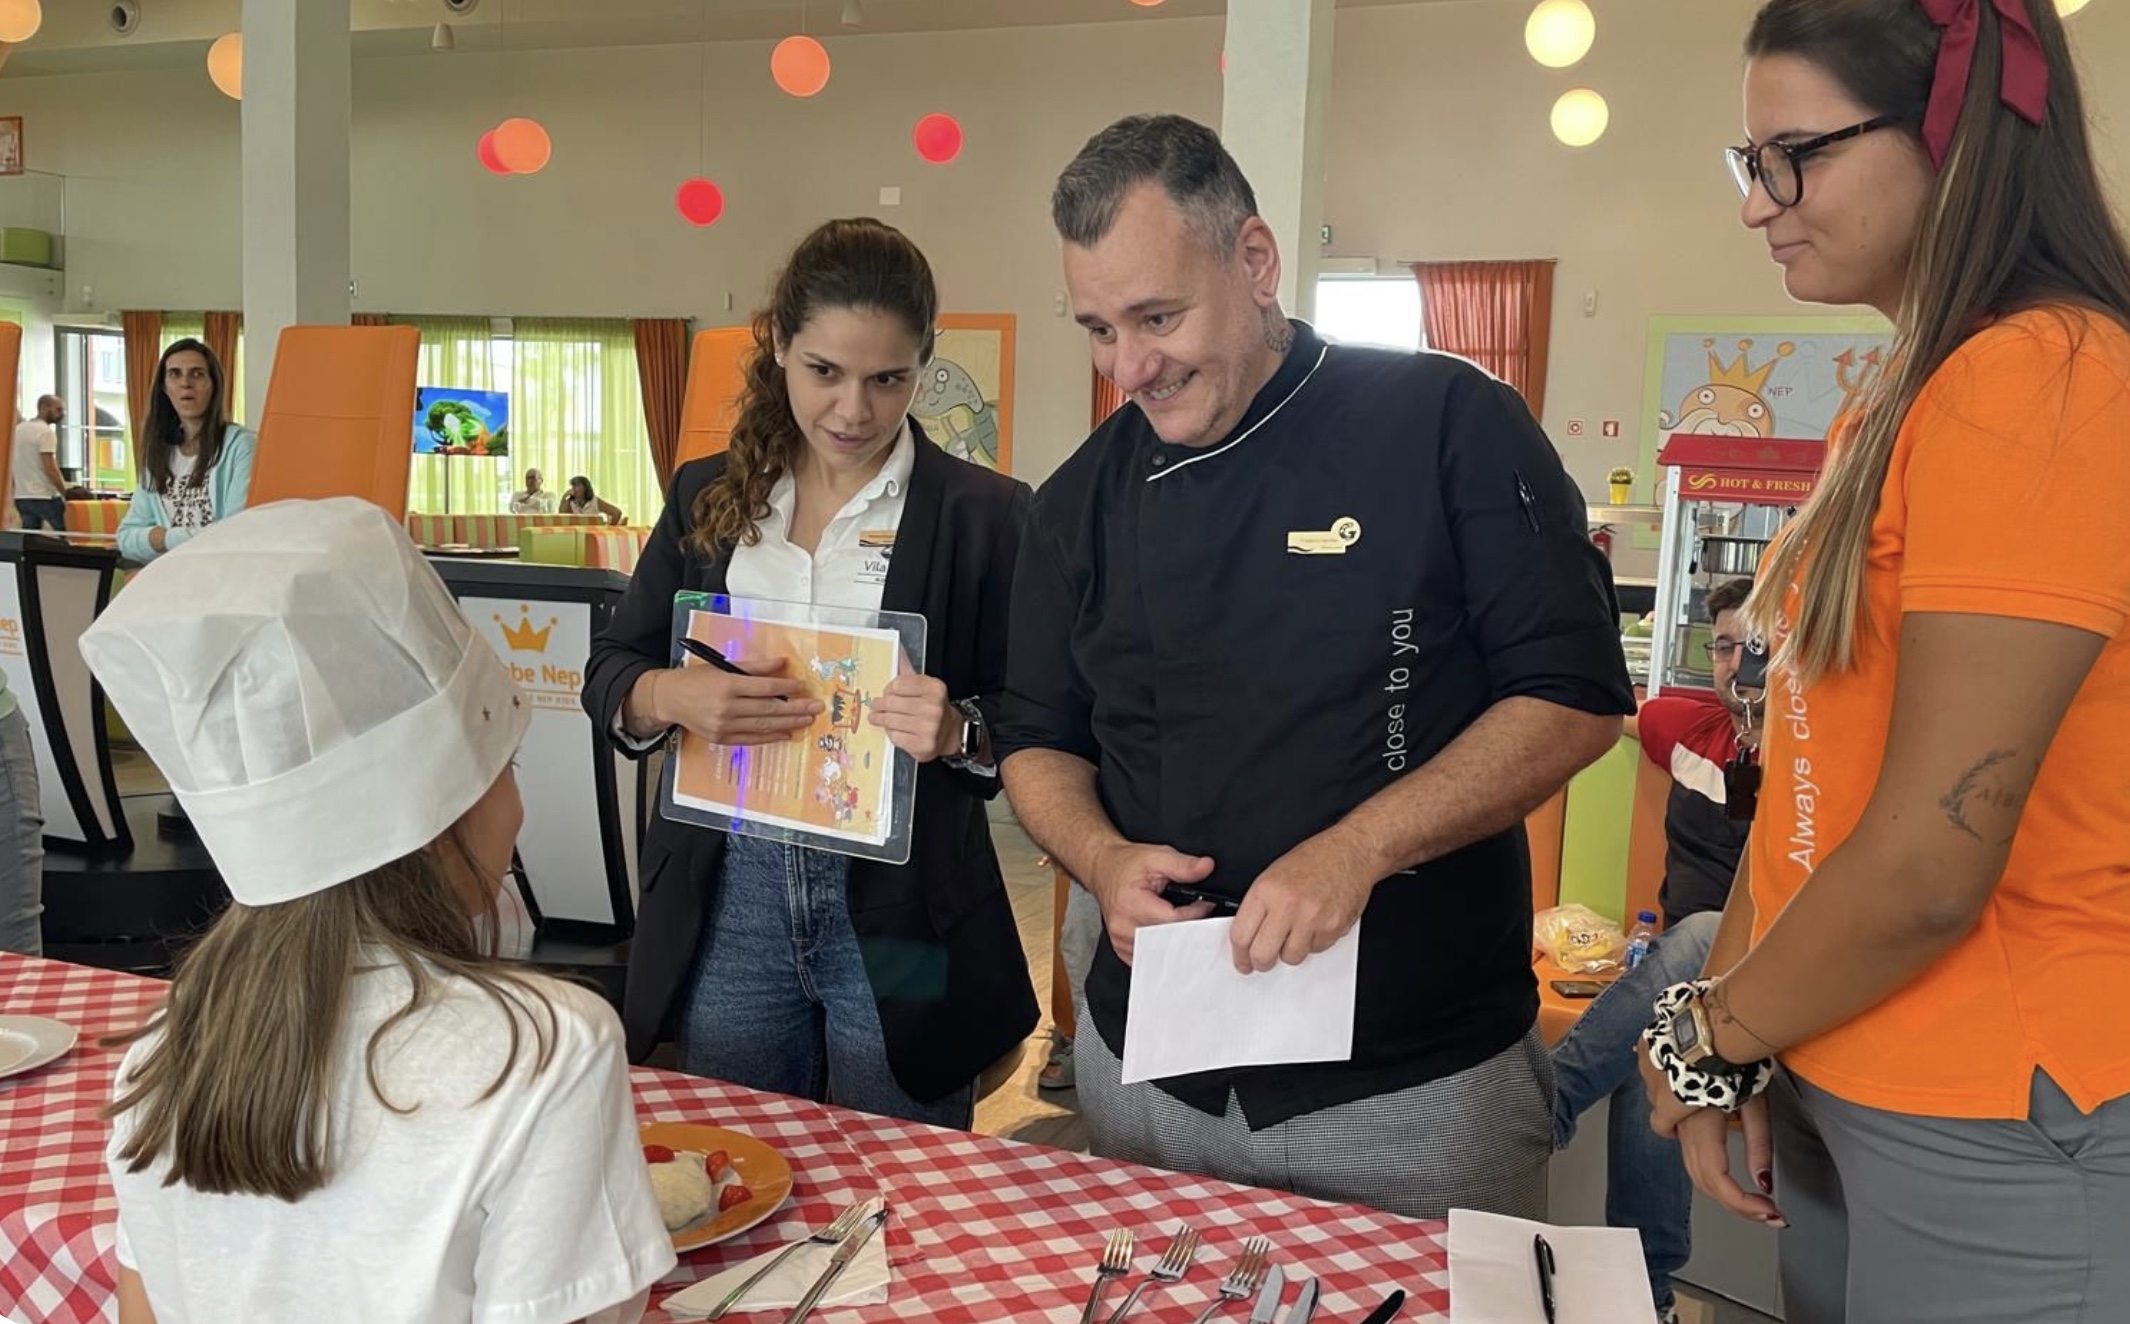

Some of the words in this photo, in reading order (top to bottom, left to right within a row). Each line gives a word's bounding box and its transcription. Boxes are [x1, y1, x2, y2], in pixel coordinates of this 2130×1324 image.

[1768, 386, 1793, 397] NEP
[1720, 477, 1750, 489] HOT
[1751, 479, 1762, 489] &
[1765, 480, 1811, 492] FRESH
[864, 559, 886, 573] Vila
[0, 618, 18, 637] ep
[1392, 608, 1419, 656] you
[541, 663, 581, 690] Nep
[1384, 667, 1409, 693] to
[1382, 703, 1408, 771] close
[1788, 757, 1821, 874] Always
